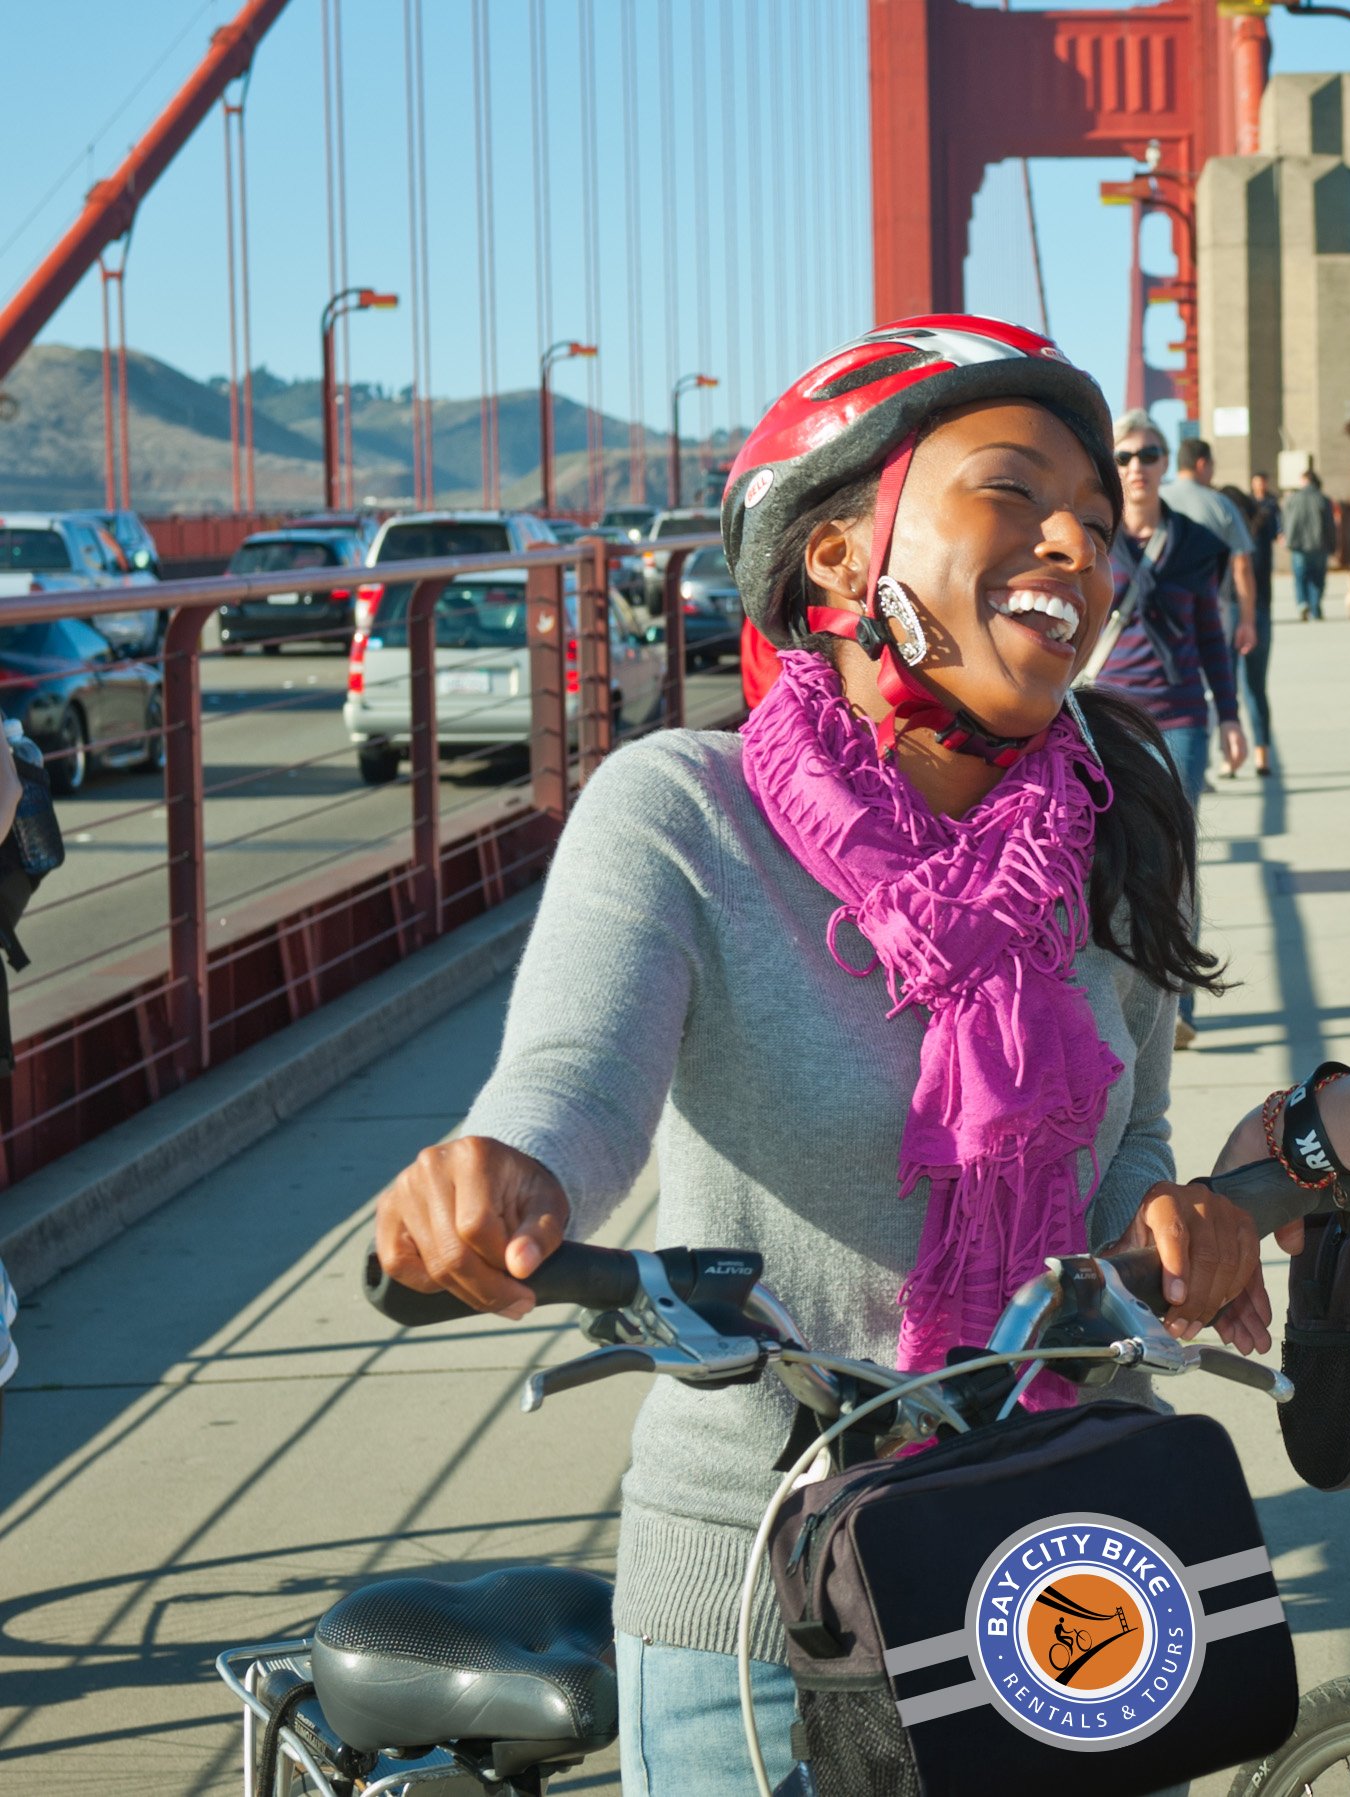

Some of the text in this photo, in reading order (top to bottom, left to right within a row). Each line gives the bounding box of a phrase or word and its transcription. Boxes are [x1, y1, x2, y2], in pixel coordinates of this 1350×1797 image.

[747, 475, 768, 503] BELL
[988, 1533, 1171, 1637] BAY CITY BIKE
[1002, 1626, 1184, 1729] RENTALS & TOURS
